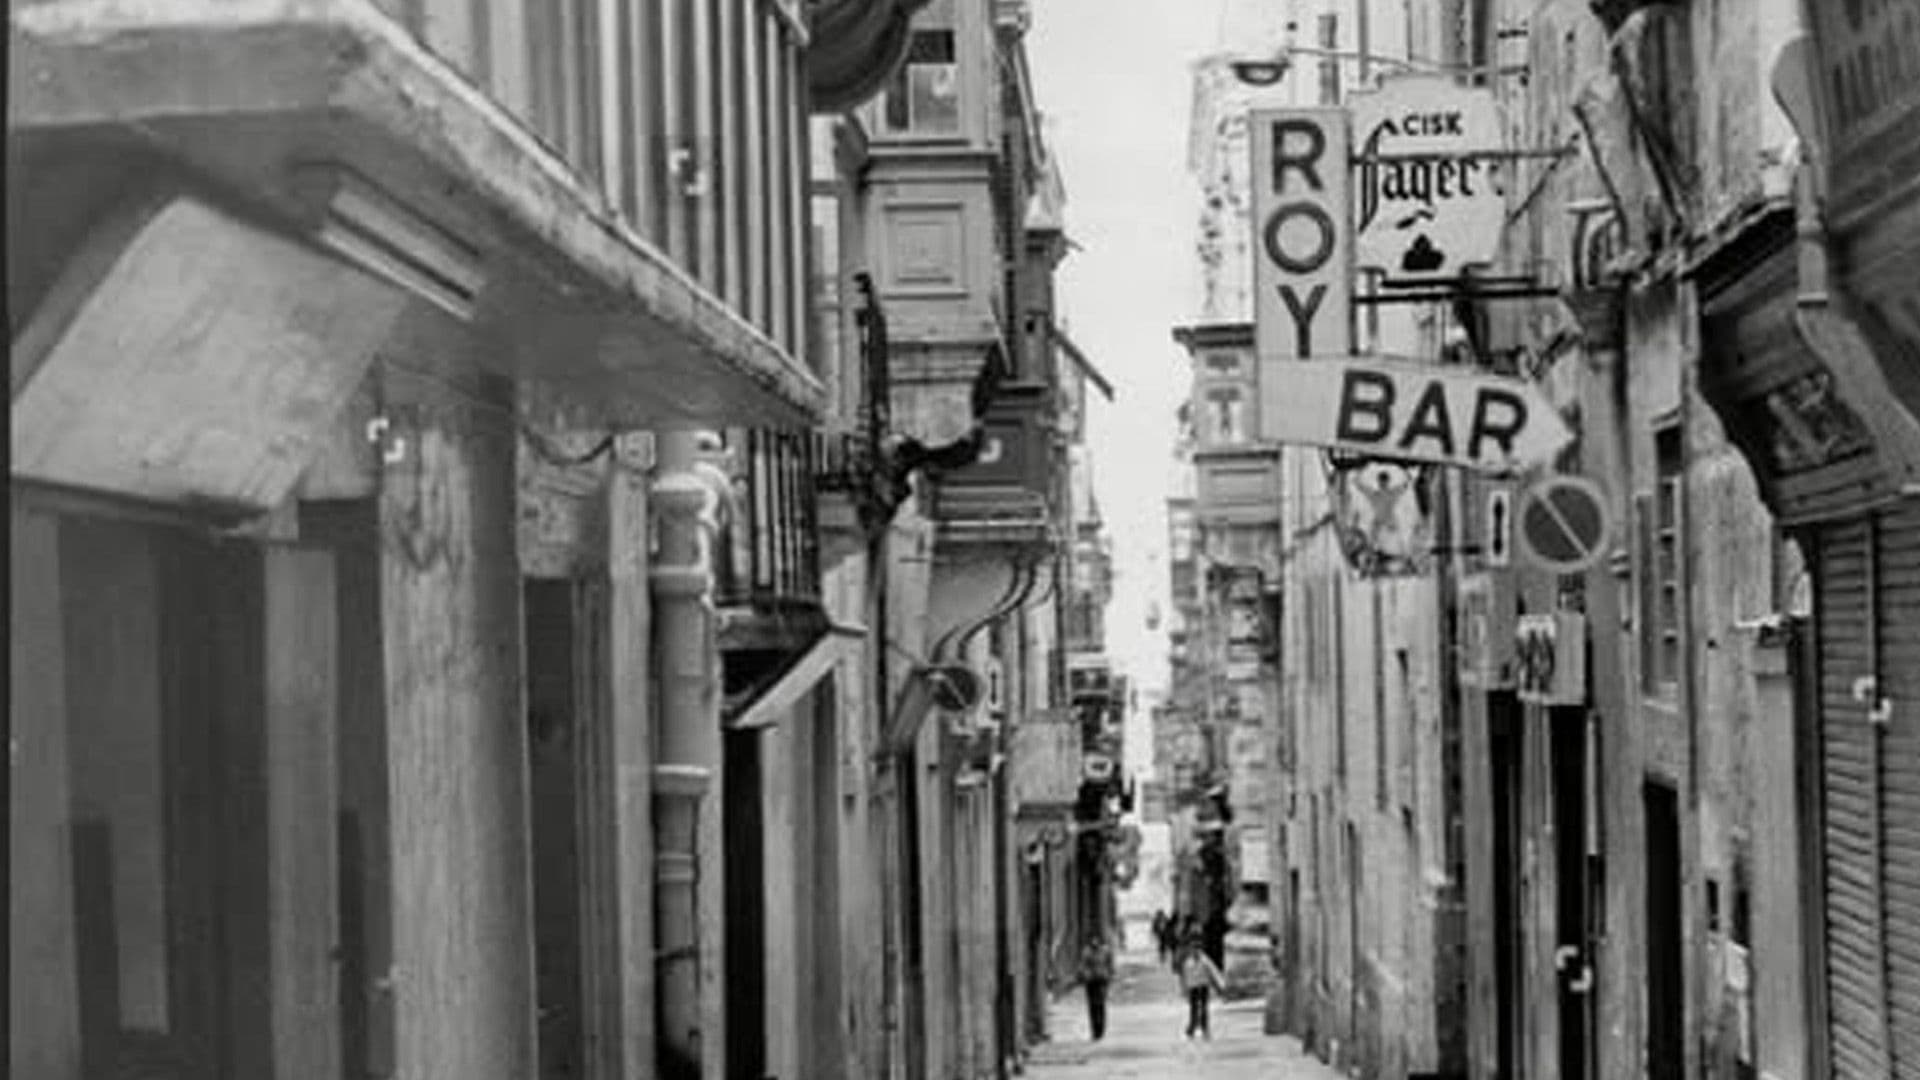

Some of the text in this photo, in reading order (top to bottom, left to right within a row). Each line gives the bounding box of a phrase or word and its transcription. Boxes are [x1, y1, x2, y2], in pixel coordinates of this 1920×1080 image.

[1402, 111, 1462, 136] CISK
[1264, 118, 1336, 360] ROY
[1336, 368, 1528, 460] BAR
